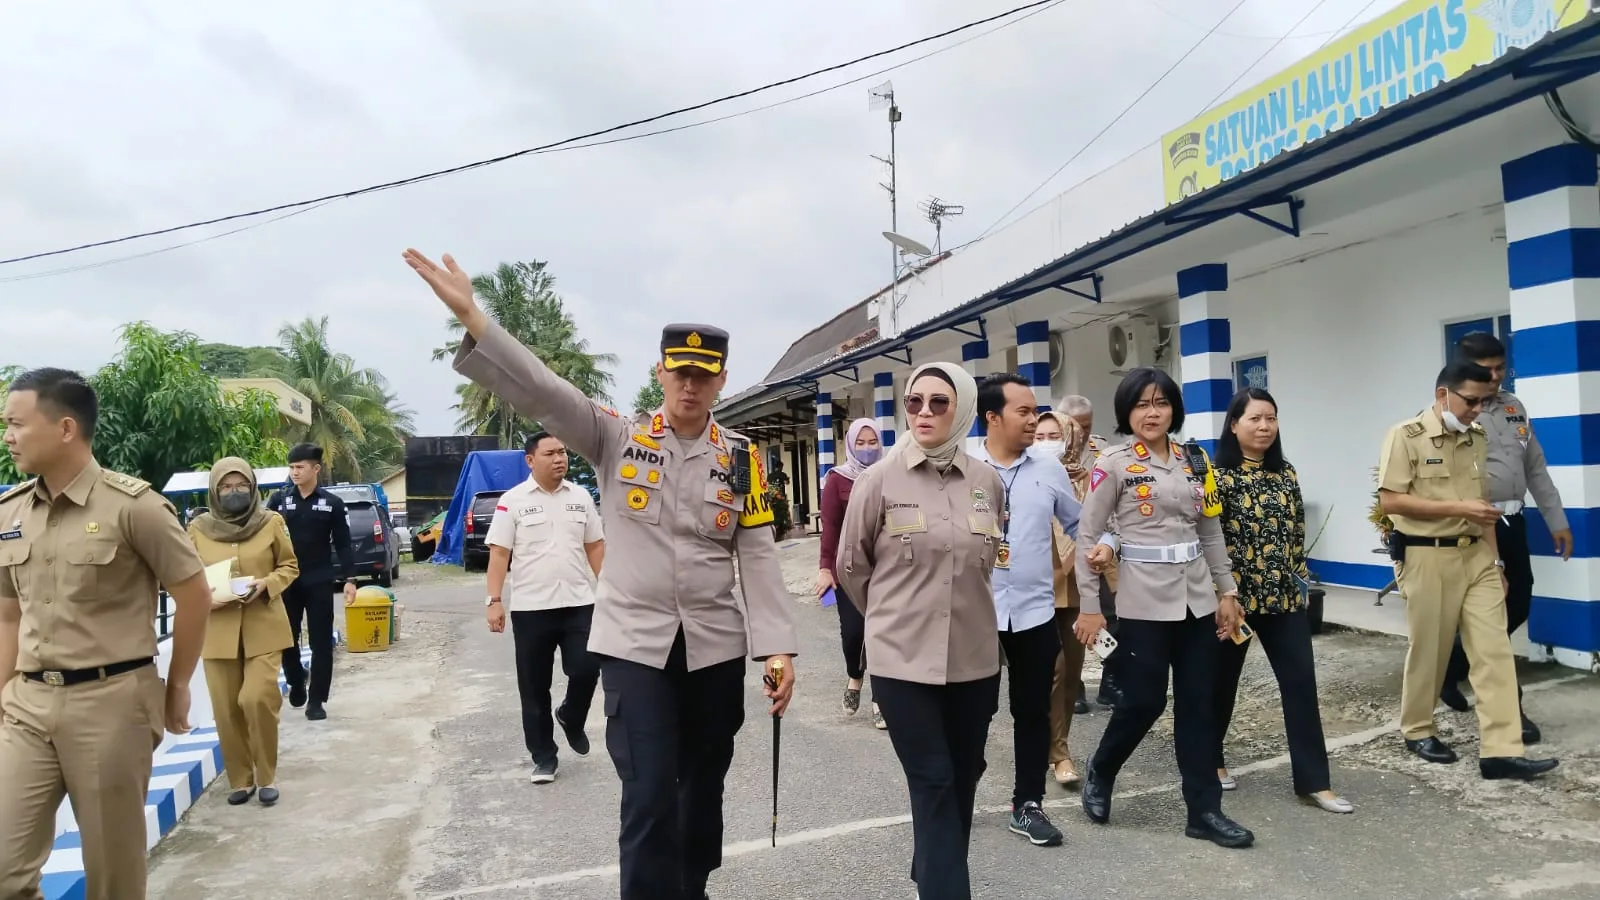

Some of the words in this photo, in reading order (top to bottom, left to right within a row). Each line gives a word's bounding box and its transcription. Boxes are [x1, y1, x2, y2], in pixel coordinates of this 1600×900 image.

[1204, 87, 1287, 167] SATUAN
[1292, 53, 1352, 124] LALU
[1358, 0, 1468, 91] LINTAS
[623, 447, 664, 466] ANDI
[709, 468, 733, 485] POL
[743, 494, 759, 518] KA
[1203, 489, 1220, 510] KAS
